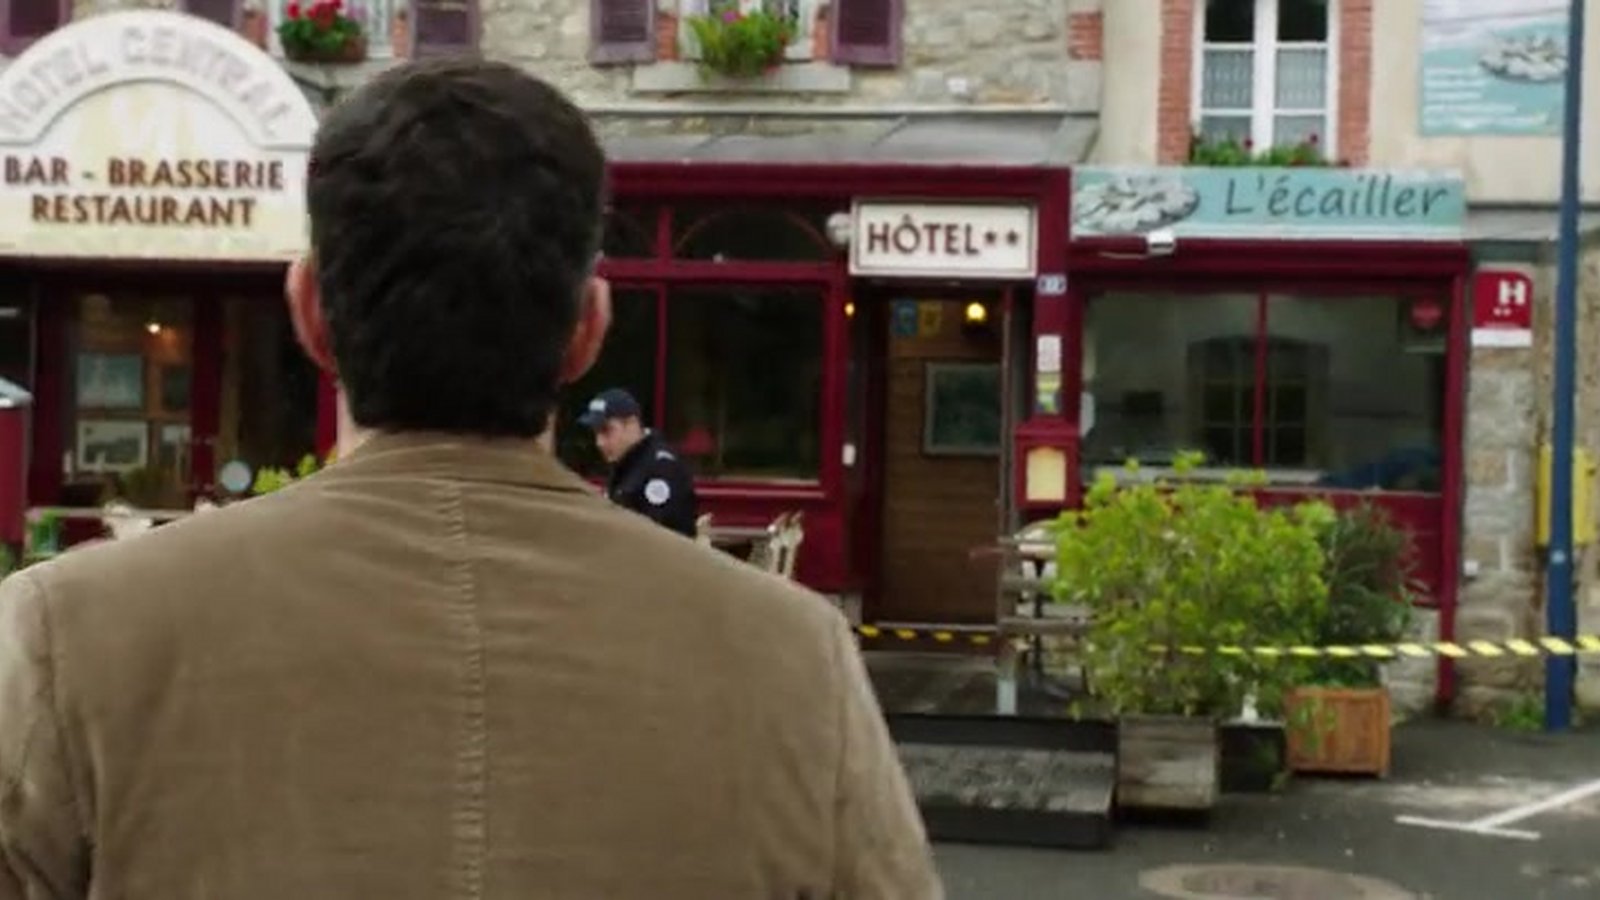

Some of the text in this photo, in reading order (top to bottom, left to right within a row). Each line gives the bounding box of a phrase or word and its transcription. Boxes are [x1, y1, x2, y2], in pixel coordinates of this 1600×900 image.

[121, 25, 291, 138] CENTRAL
[5, 156, 69, 186] BAR
[108, 157, 285, 191] BRASSERIE
[31, 194, 256, 226] RESTAURANT
[1225, 174, 1449, 217] L'écailler
